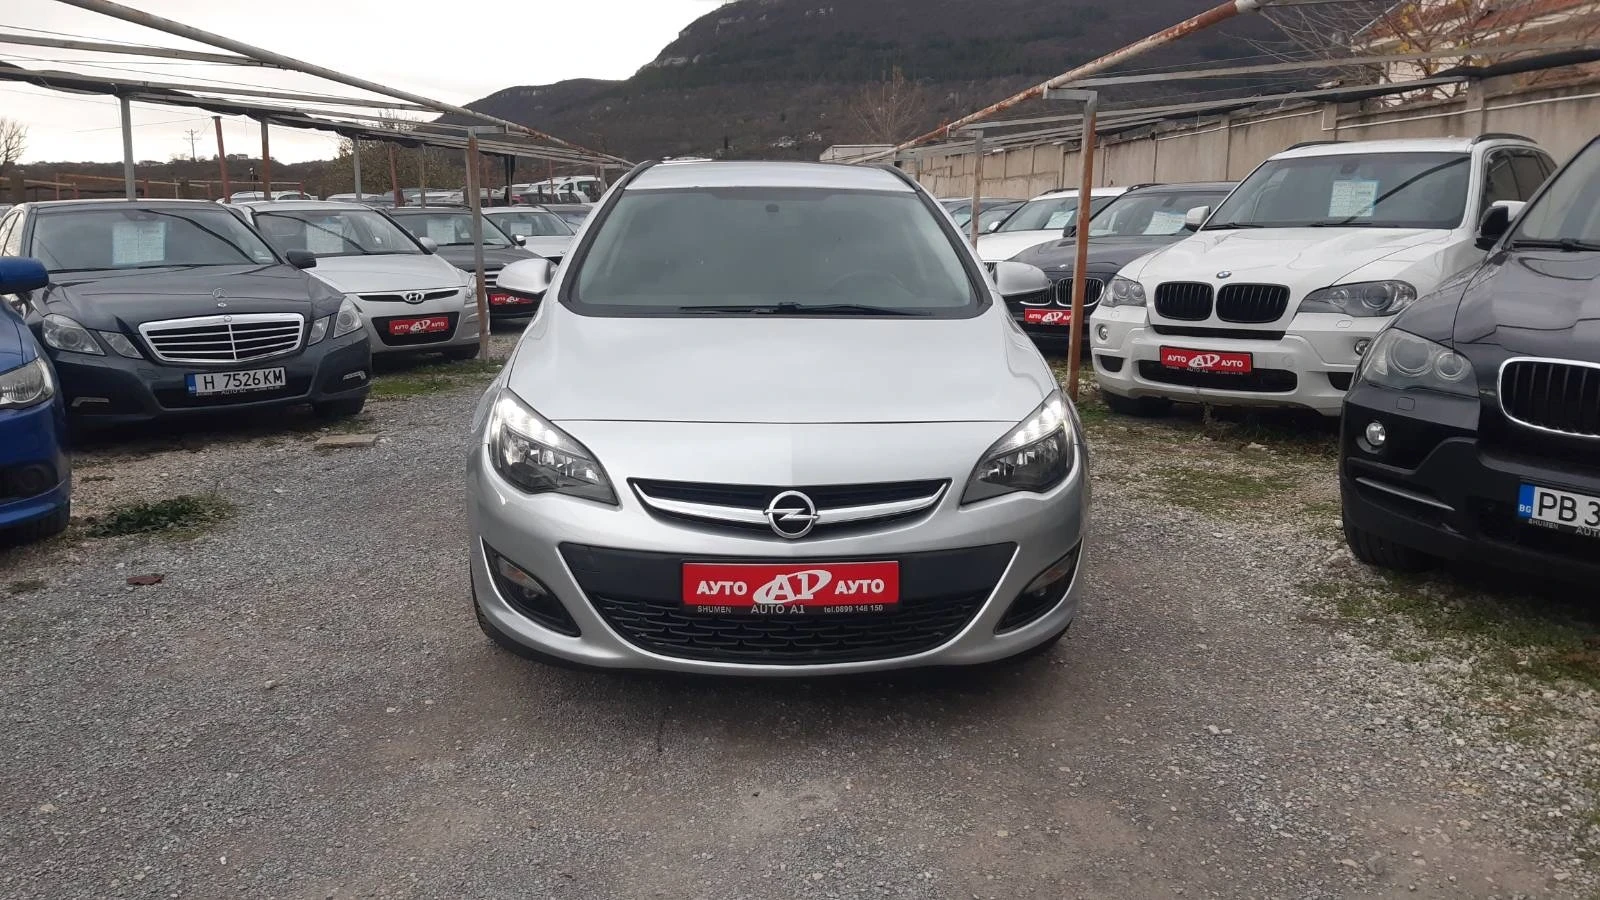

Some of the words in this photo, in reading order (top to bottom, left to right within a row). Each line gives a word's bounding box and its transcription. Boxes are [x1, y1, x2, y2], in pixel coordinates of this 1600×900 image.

[1167, 354, 1187, 363] АУТО
[1221, 359, 1244, 368] АУТО
[203, 375, 215, 390] H
[1519, 504, 1532, 513] BG
[1538, 492, 1577, 522] PB
[696, 580, 748, 596] АУТО
[834, 578, 885, 595] АУТО
[697, 605, 732, 613] SHUMEN
[750, 603, 785, 614] AUTO
[789, 603, 805, 614] A1
